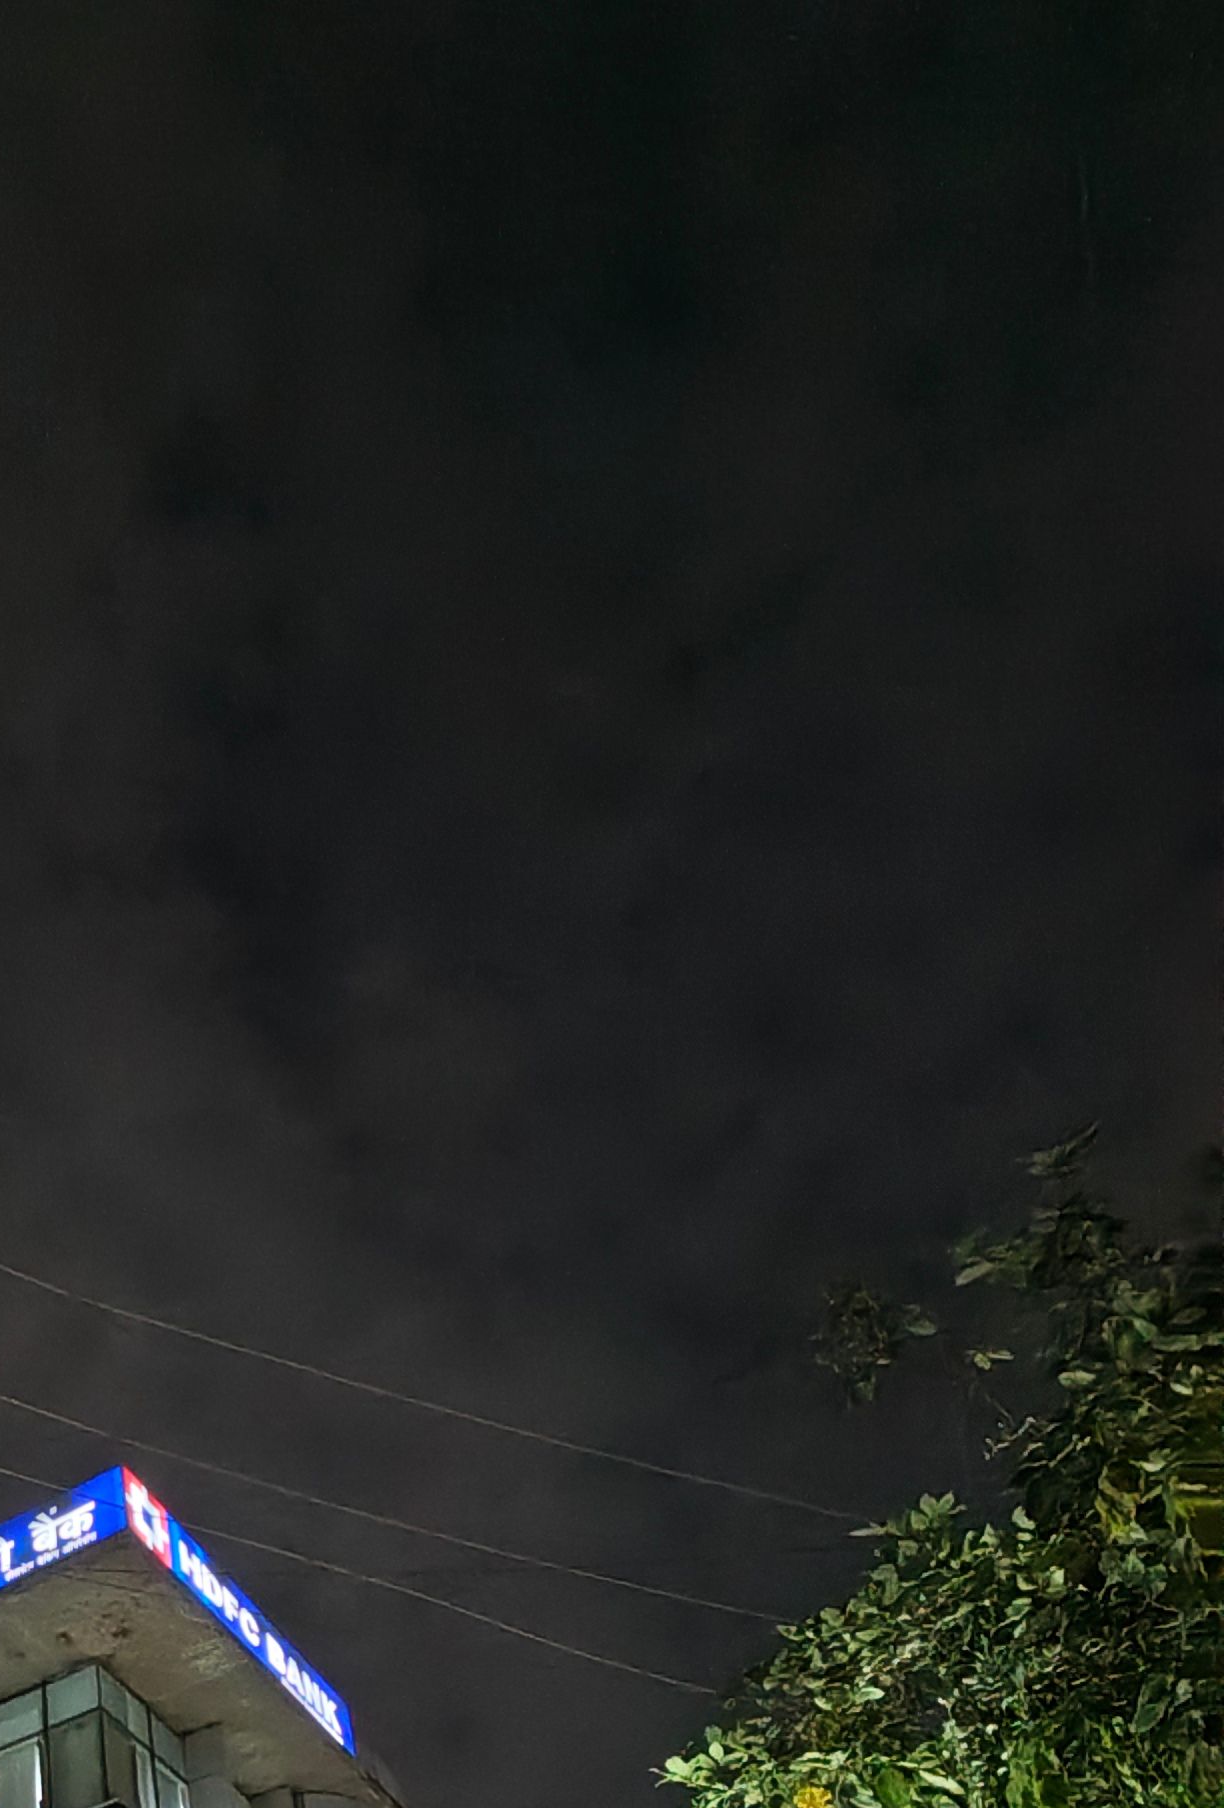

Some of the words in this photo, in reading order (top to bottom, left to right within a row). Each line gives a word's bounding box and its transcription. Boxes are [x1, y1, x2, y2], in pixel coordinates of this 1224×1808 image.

[28, 1500, 96, 1552] बैंक
[178, 1540, 261, 1647] HDFC
[265, 1632, 343, 1736] BANK
